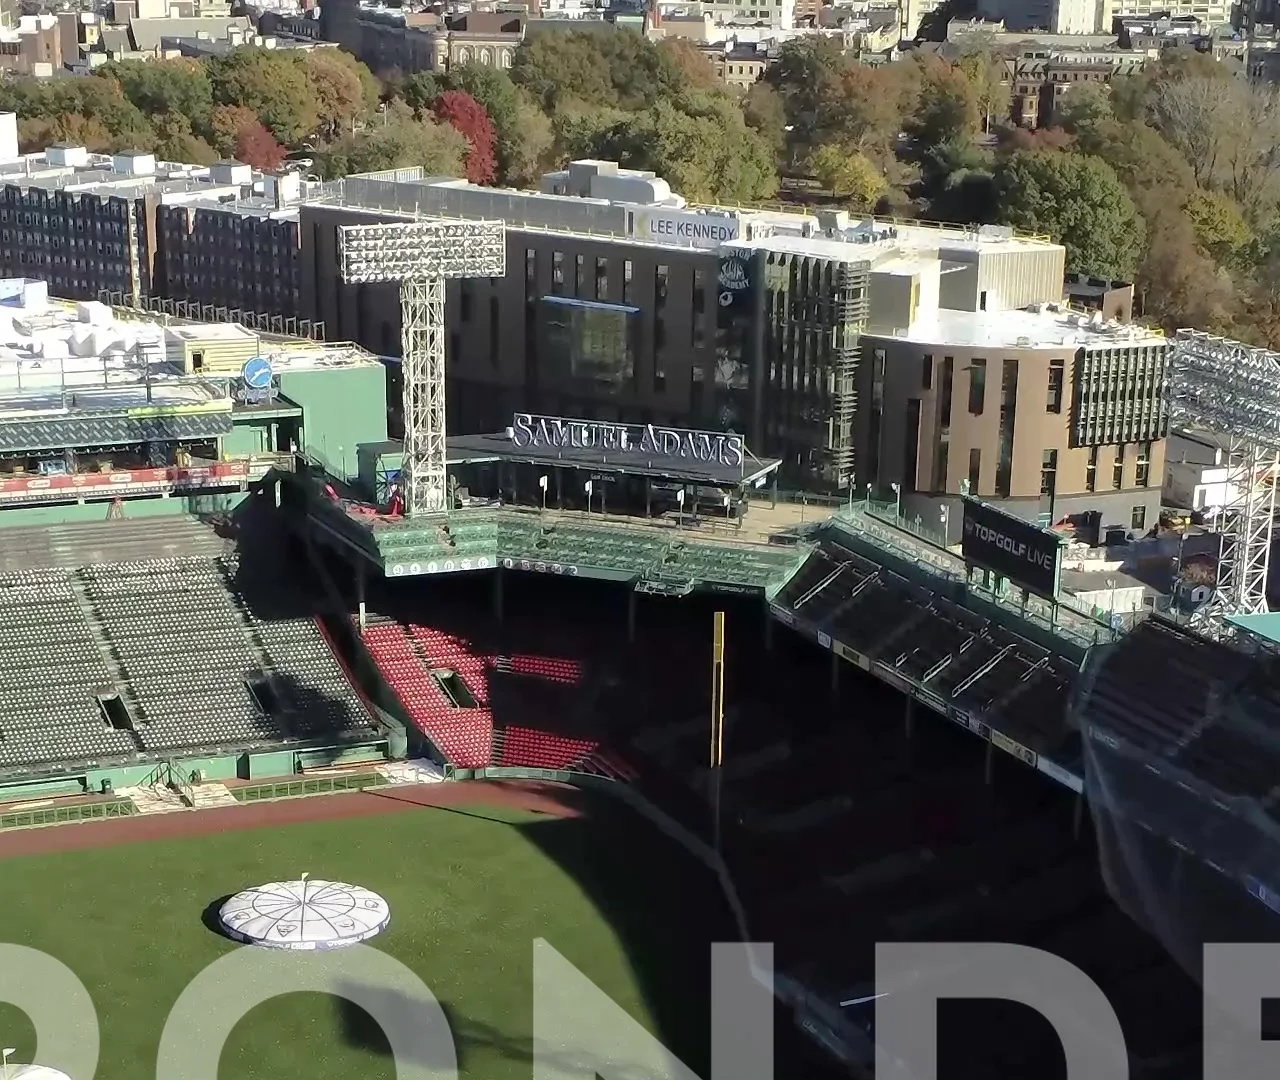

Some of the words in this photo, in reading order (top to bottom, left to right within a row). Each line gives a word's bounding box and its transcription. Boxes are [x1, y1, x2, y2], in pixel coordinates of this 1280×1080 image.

[650, 220, 673, 234] LEE
[677, 222, 736, 241] KENNEDY
[513, 413, 633, 451] SAMUEL
[640, 424, 742, 466] ADAMS
[974, 523, 1026, 557] TOPGOLF
[1027, 546, 1053, 570] LIVE
